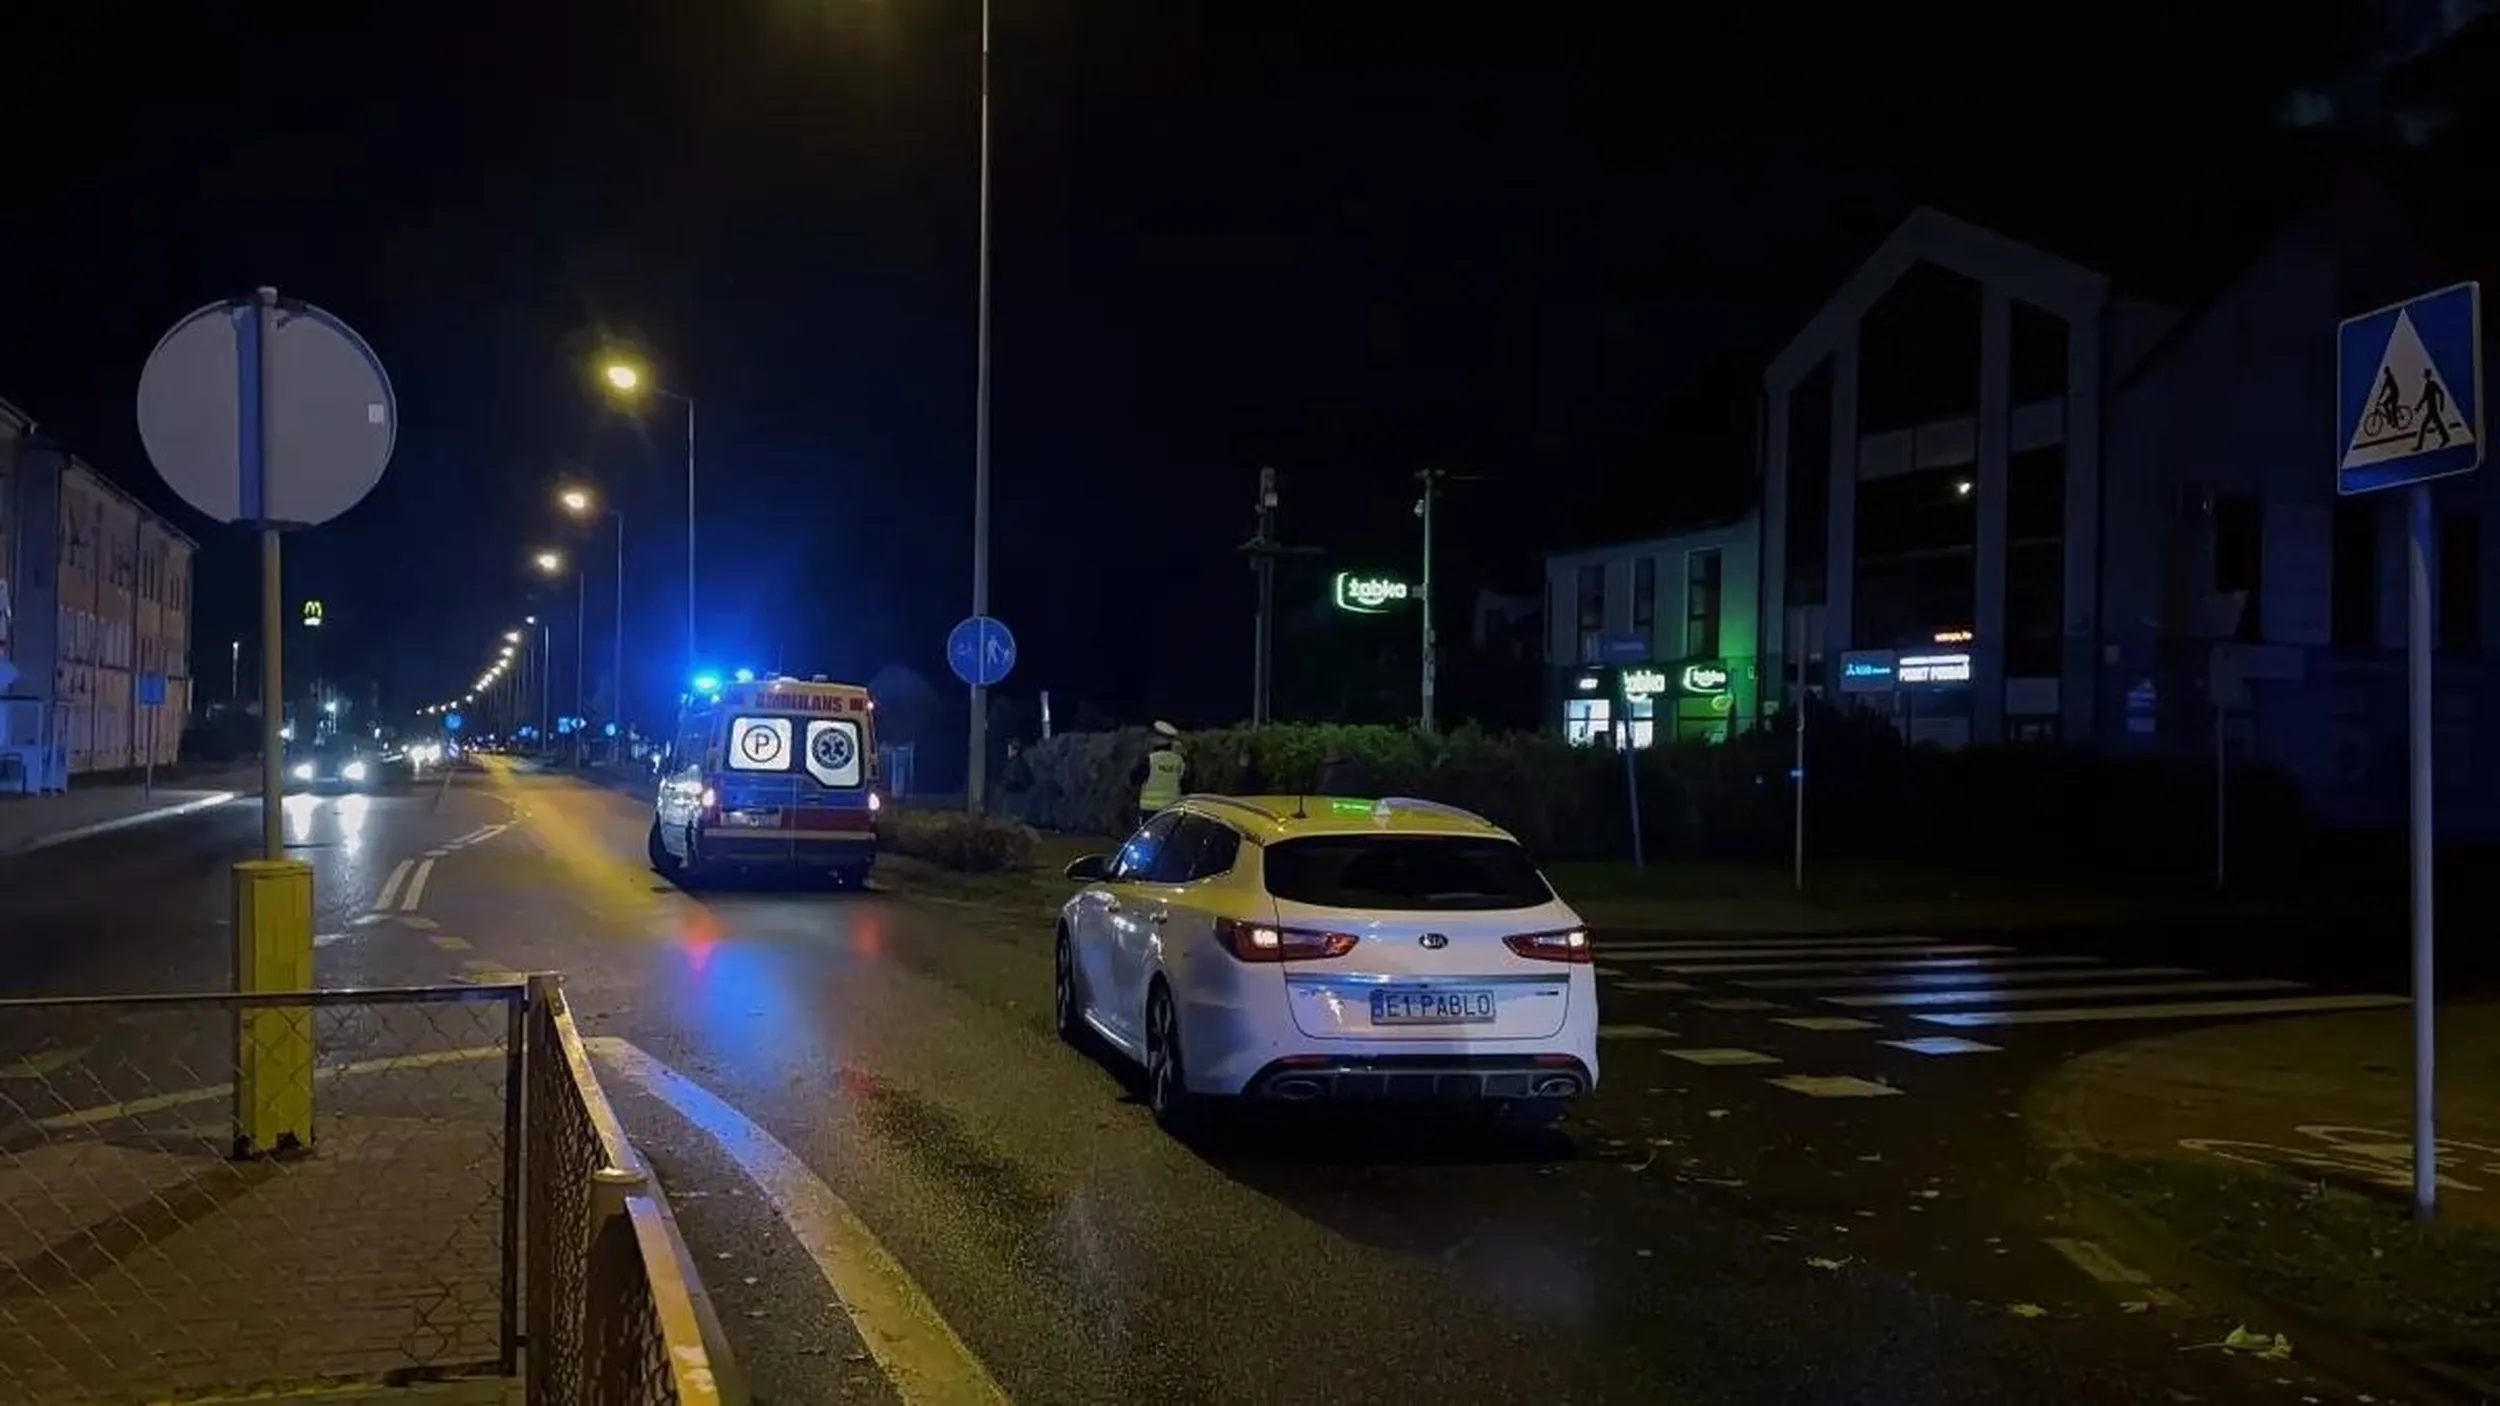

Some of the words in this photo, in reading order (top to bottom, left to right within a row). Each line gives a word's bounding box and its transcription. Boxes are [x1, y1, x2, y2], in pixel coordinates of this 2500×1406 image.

[1348, 577, 1407, 602] żabka
[755, 691, 843, 713] AMBULANS
[754, 732, 770, 755] P
[1386, 995, 1412, 1017] E1
[1420, 994, 1491, 1017] PABLO
